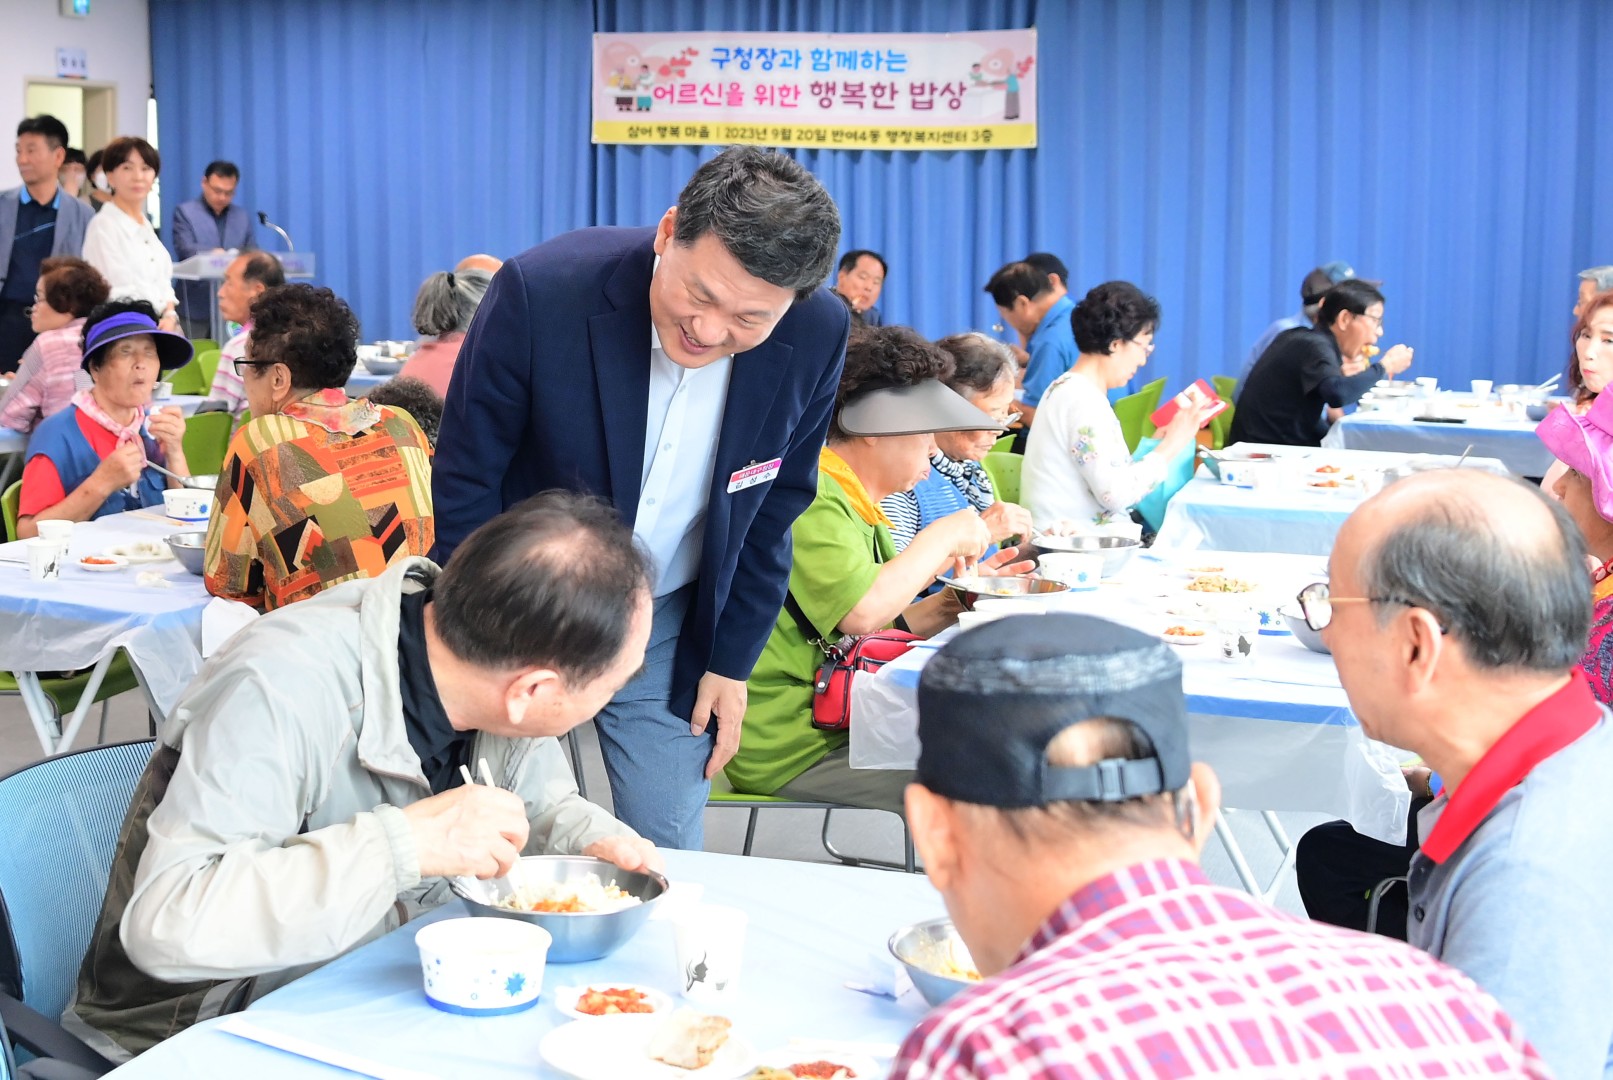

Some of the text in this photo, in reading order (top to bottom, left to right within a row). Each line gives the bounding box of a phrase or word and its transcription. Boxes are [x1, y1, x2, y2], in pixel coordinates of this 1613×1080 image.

[710, 47, 908, 72] 구청장과 함께하는
[653, 80, 967, 110] 어르신을 위한 행복한 밥상
[656, 125, 681, 139] 행복
[684, 125, 710, 139] 마을
[725, 126, 768, 141] 2023년
[771, 127, 792, 141] 9월
[796, 128, 827, 142] 20일
[831, 128, 880, 144] 반여4동
[885, 129, 968, 144] 행정복지센터
[971, 128, 993, 143] 3층
